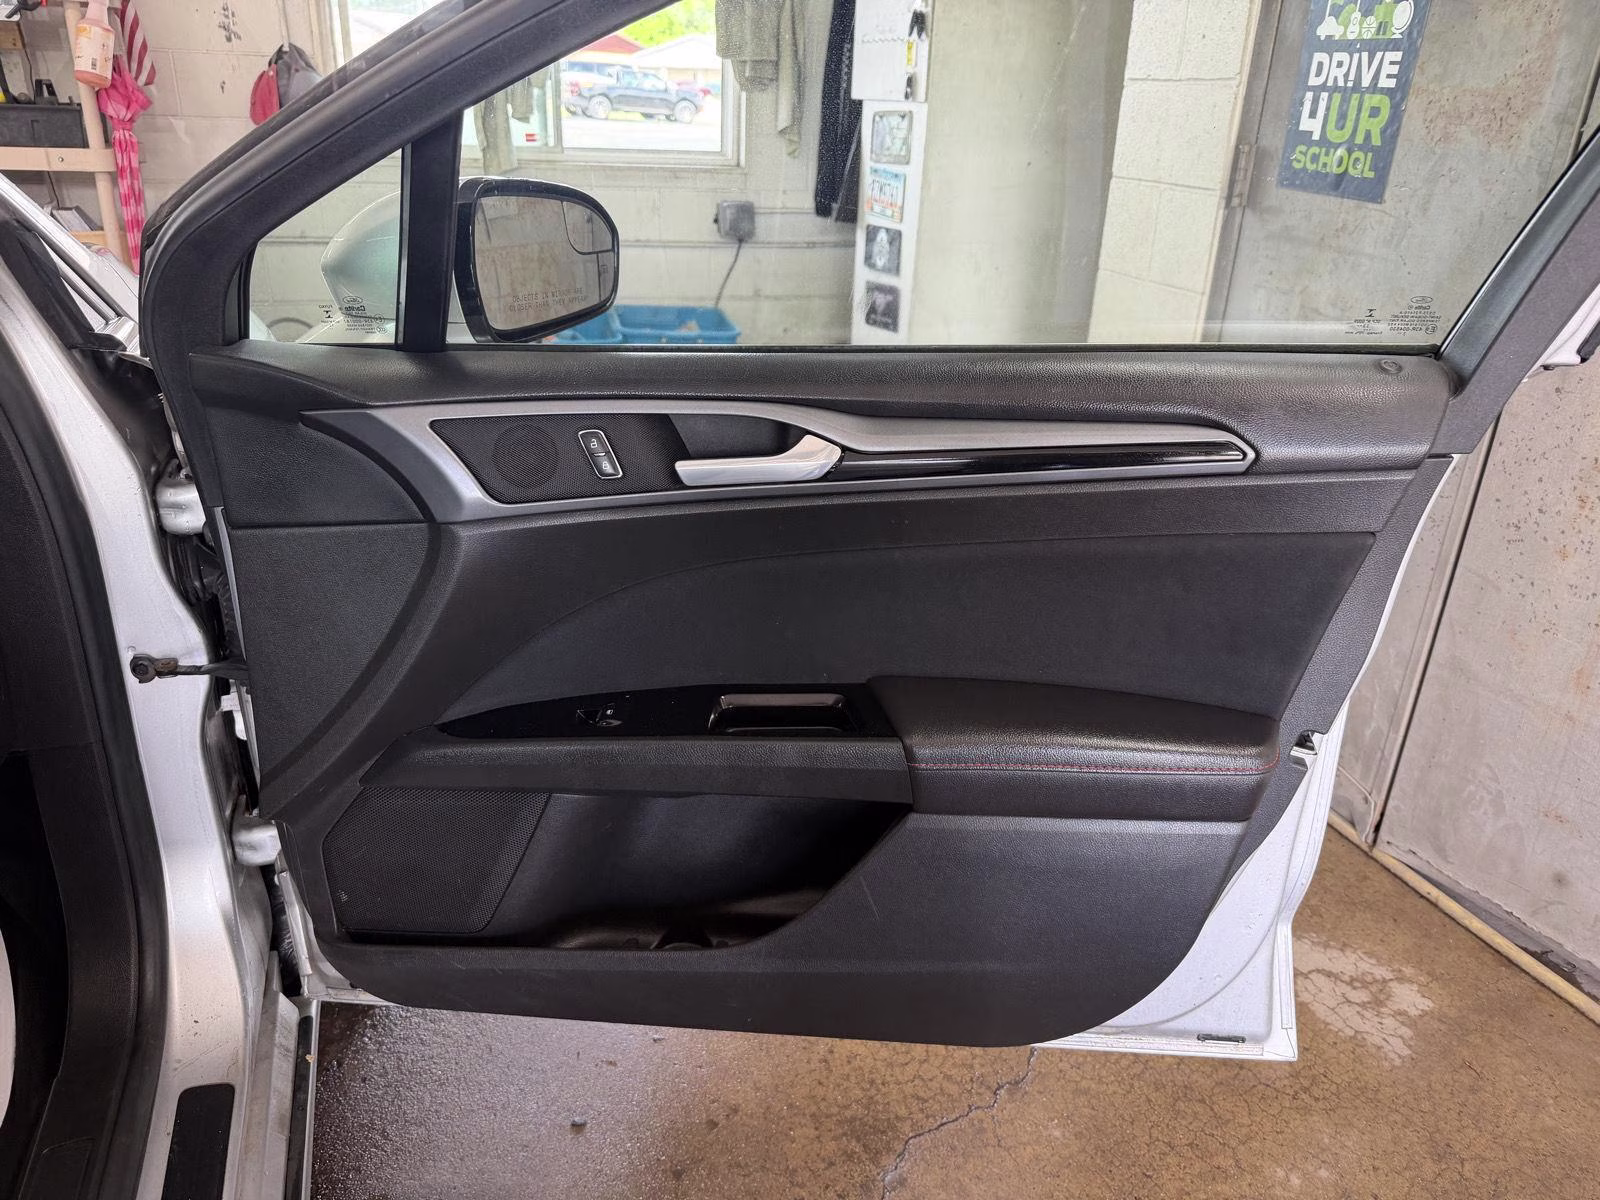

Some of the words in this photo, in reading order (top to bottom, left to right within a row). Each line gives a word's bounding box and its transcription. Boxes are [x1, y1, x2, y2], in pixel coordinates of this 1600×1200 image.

[1299, 91, 1391, 146] 4UR
[1292, 144, 1375, 178] SCHOOL
[509, 302, 533, 312] CLOSER
[512, 293, 539, 303] OBJECTS
